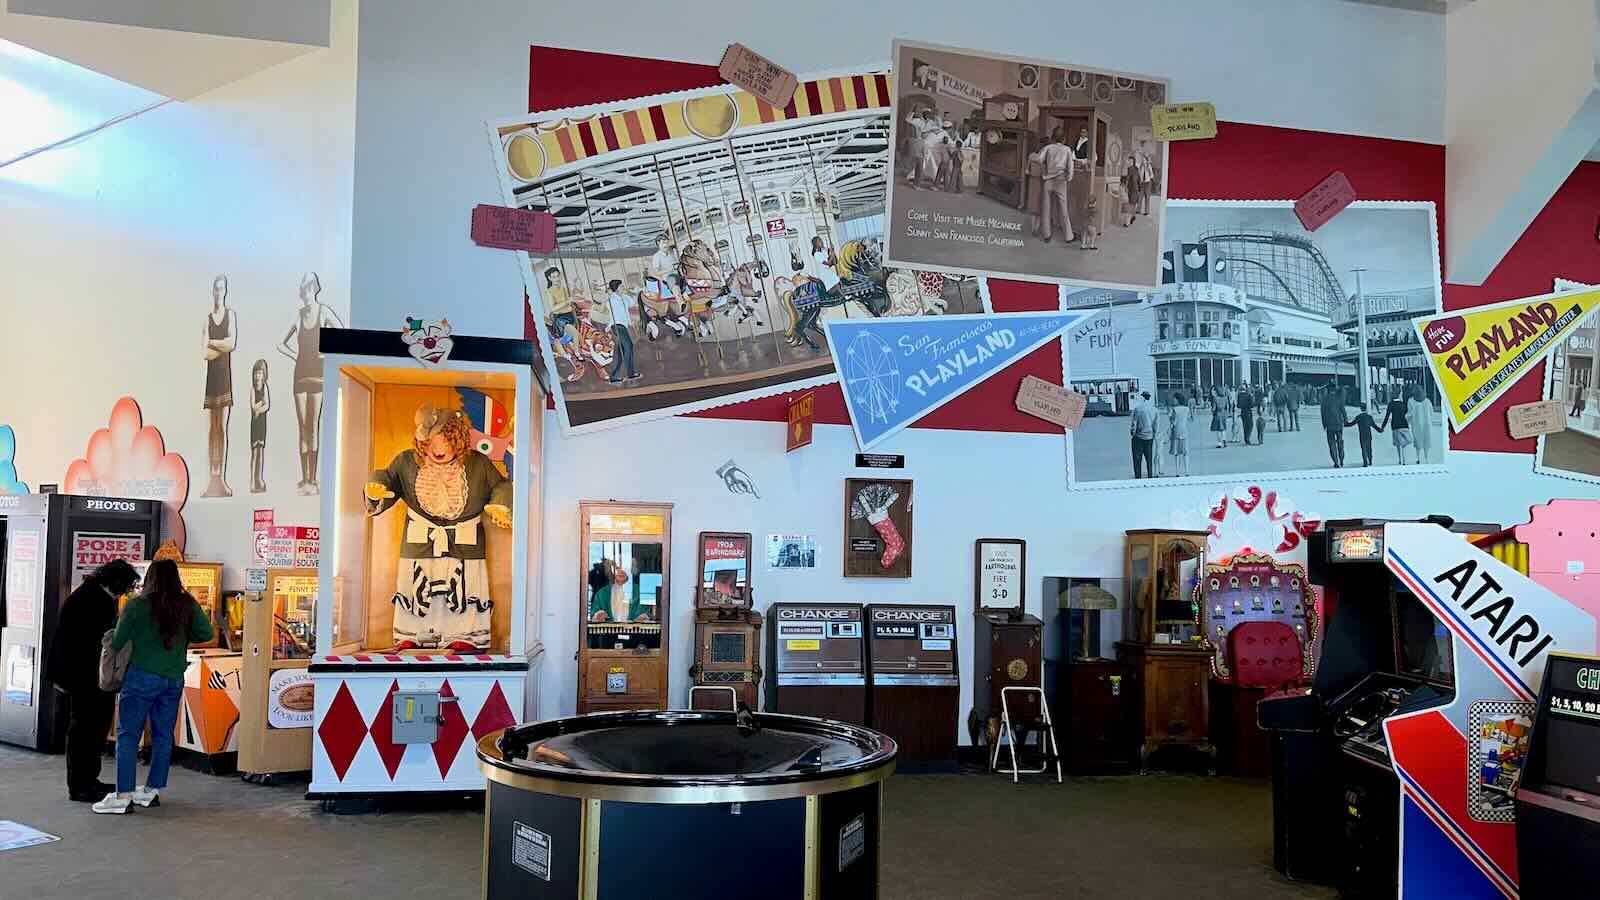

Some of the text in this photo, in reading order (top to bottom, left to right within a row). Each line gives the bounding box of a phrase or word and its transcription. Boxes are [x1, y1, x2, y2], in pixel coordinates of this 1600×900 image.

[907, 209, 929, 221] COME
[933, 212, 950, 223] VISIT
[933, 229, 949, 240] SAN
[1074, 323, 1093, 345] ALL
[1435, 330, 1455, 351] FUN
[1445, 302, 1558, 382] PLAYLAND
[898, 334, 931, 357] San
[905, 328, 1016, 397] PLAYLAND
[1464, 395, 1478, 411] THE
[1499, 355, 1526, 381] GREATEST
[1525, 327, 1557, 359] AMUSEMENT
[1554, 308, 1577, 331] CENTER
[788, 397, 815, 424] CHANGE
[87, 499, 136, 511] PHOTOS
[78, 539, 143, 552] POSE 4
[992, 588, 1008, 599] 3-D
[781, 610, 848, 619] CHANGE
[875, 611, 942, 621] CHANGE
[1433, 559, 1554, 668] ATARI
[1577, 667, 1600, 690] CH
[1551, 696, 1562, 709] $1,
[1572, 700, 1583, 712] 10,
[1585, 702, 1596, 713] 20
